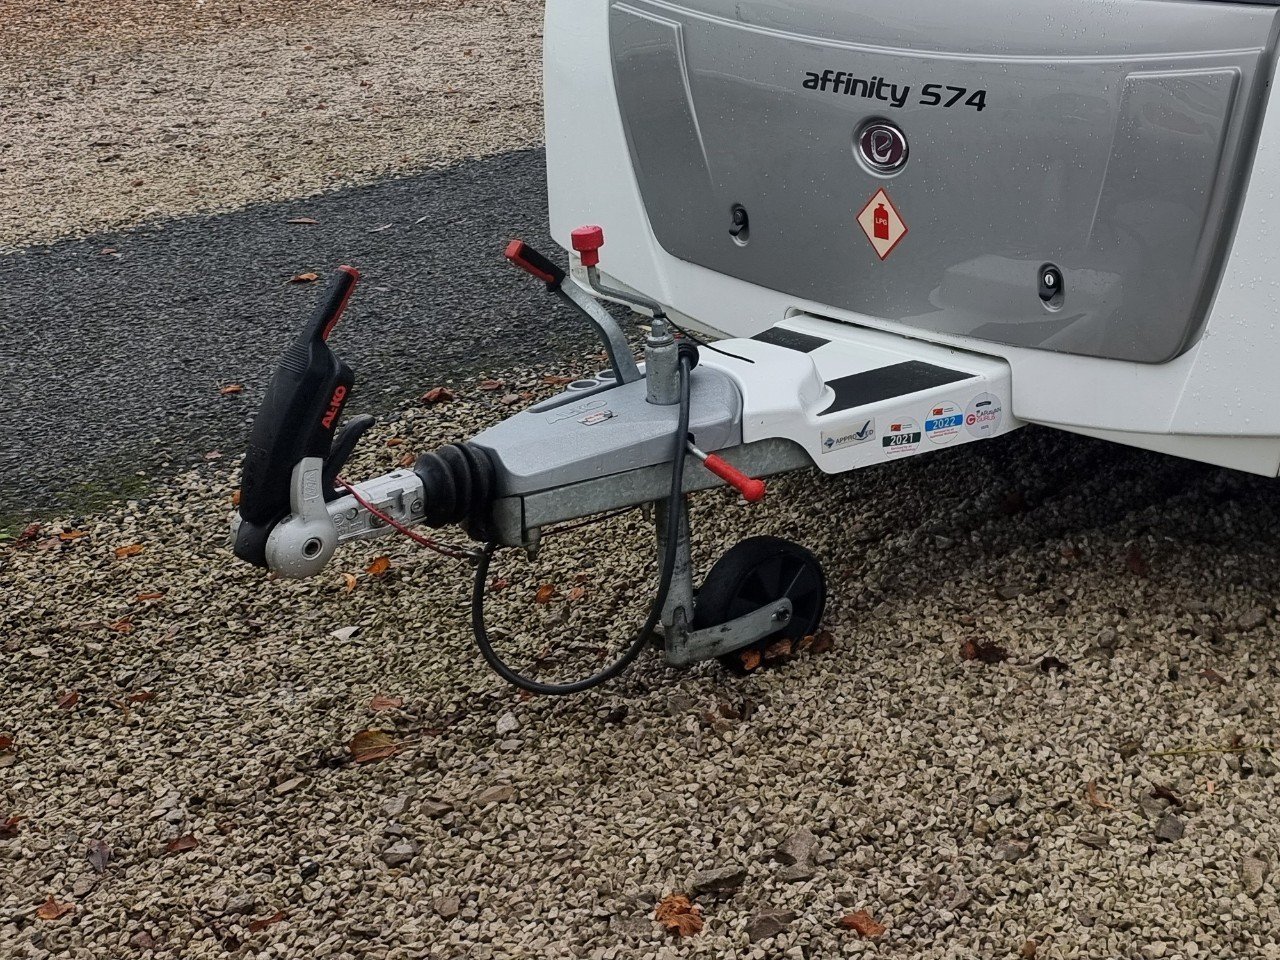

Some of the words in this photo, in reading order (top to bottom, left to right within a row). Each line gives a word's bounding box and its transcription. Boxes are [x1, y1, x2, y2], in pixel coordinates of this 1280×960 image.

[802, 69, 910, 108] affinity
[919, 83, 987, 112] 574
[875, 216, 888, 226] LPG
[322, 385, 347, 429] AL-KO
[932, 416, 956, 430] 2022
[889, 433, 914, 446] 2021
